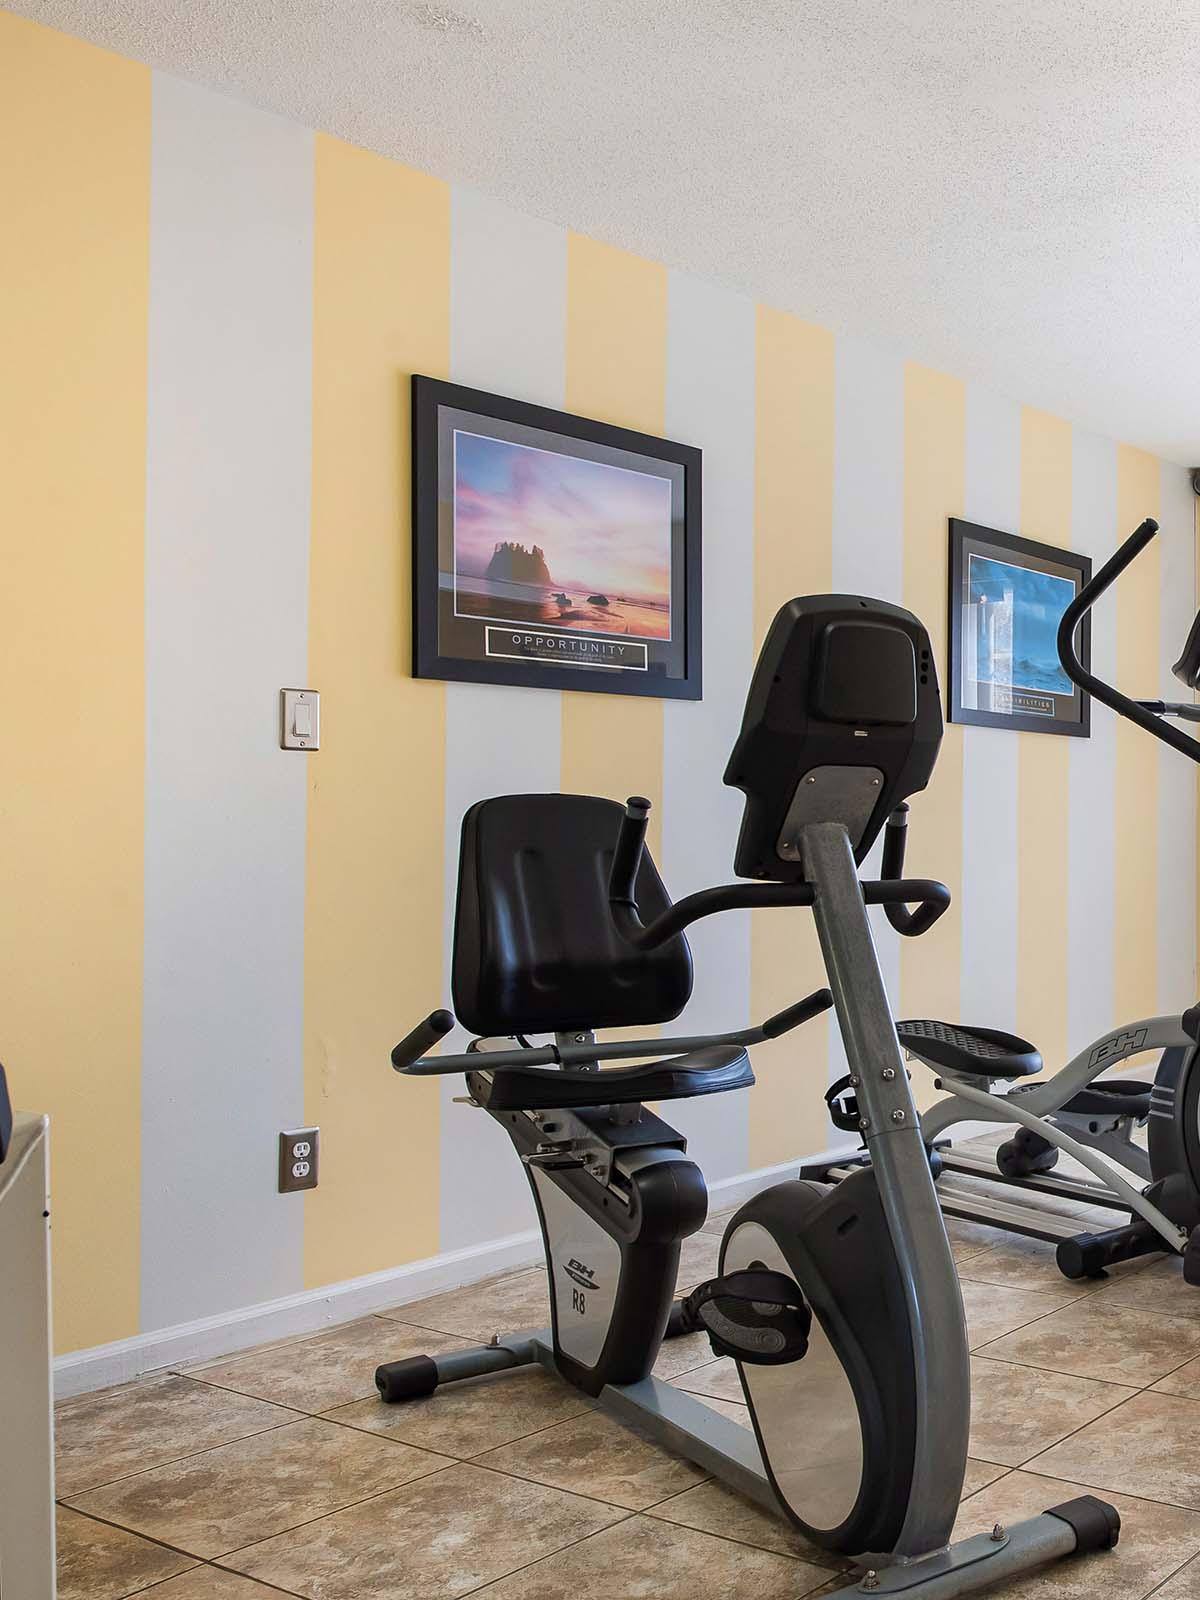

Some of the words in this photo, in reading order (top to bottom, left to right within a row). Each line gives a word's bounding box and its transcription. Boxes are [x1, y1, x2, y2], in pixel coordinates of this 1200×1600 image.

[512, 634, 625, 656] OPPORTUNITY
[1088, 1027, 1149, 1069] BH
[568, 1258, 595, 1279] BH
[572, 1287, 586, 1316] R8
